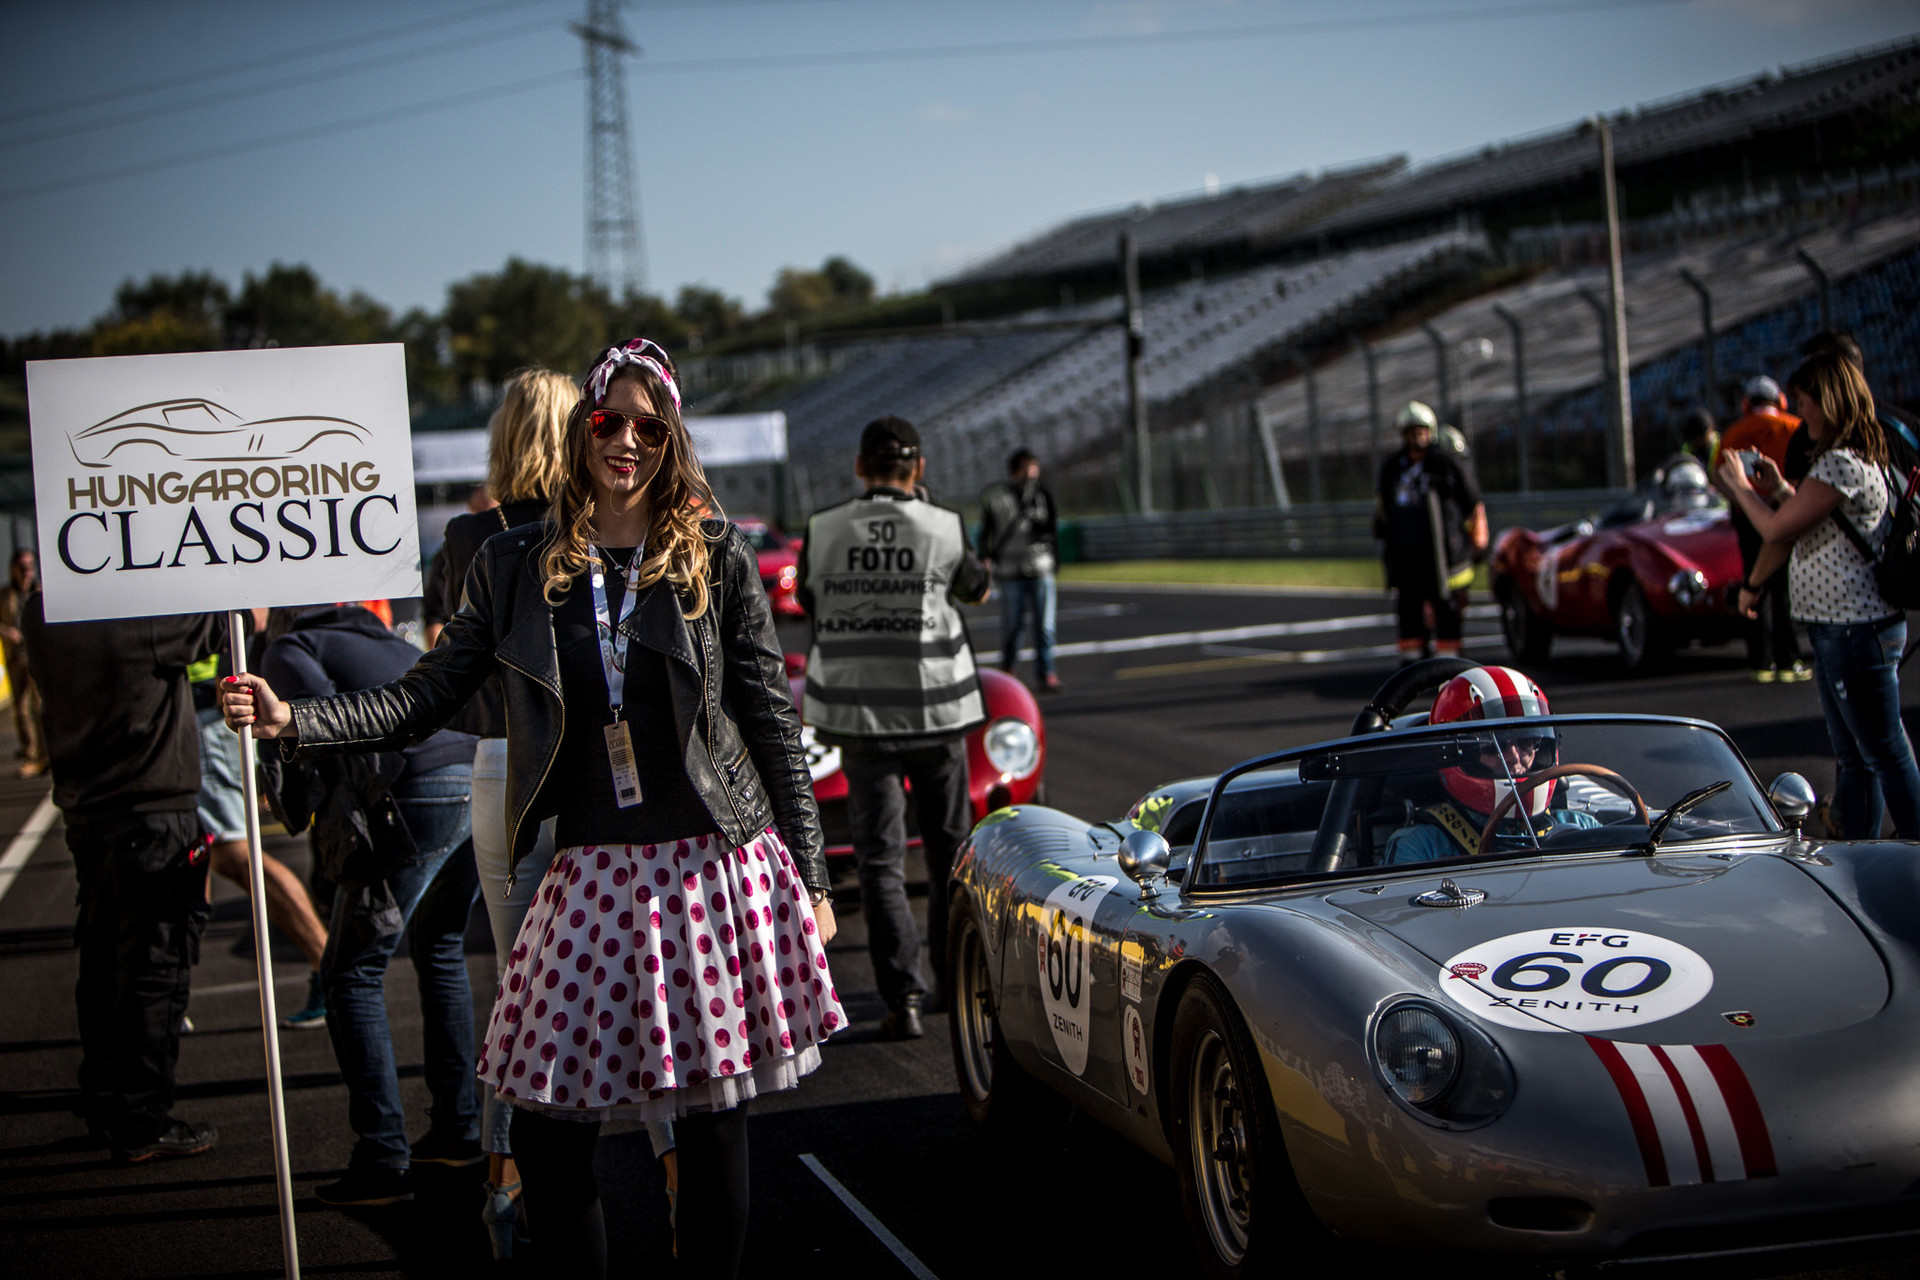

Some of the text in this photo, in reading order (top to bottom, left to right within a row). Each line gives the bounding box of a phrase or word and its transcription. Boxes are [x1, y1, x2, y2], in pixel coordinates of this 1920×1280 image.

[68, 461, 380, 509] HUNGARORING
[57, 494, 402, 574] CLASSIC
[868, 520, 895, 543] 50
[848, 547, 914, 571] FOTO
[1550, 932, 1629, 948] EFG
[1047, 908, 1083, 1009] 60
[1491, 951, 1672, 998] 60
[1488, 997, 1639, 1014] ZENITH
[1053, 1012, 1083, 1042] ZENITH
